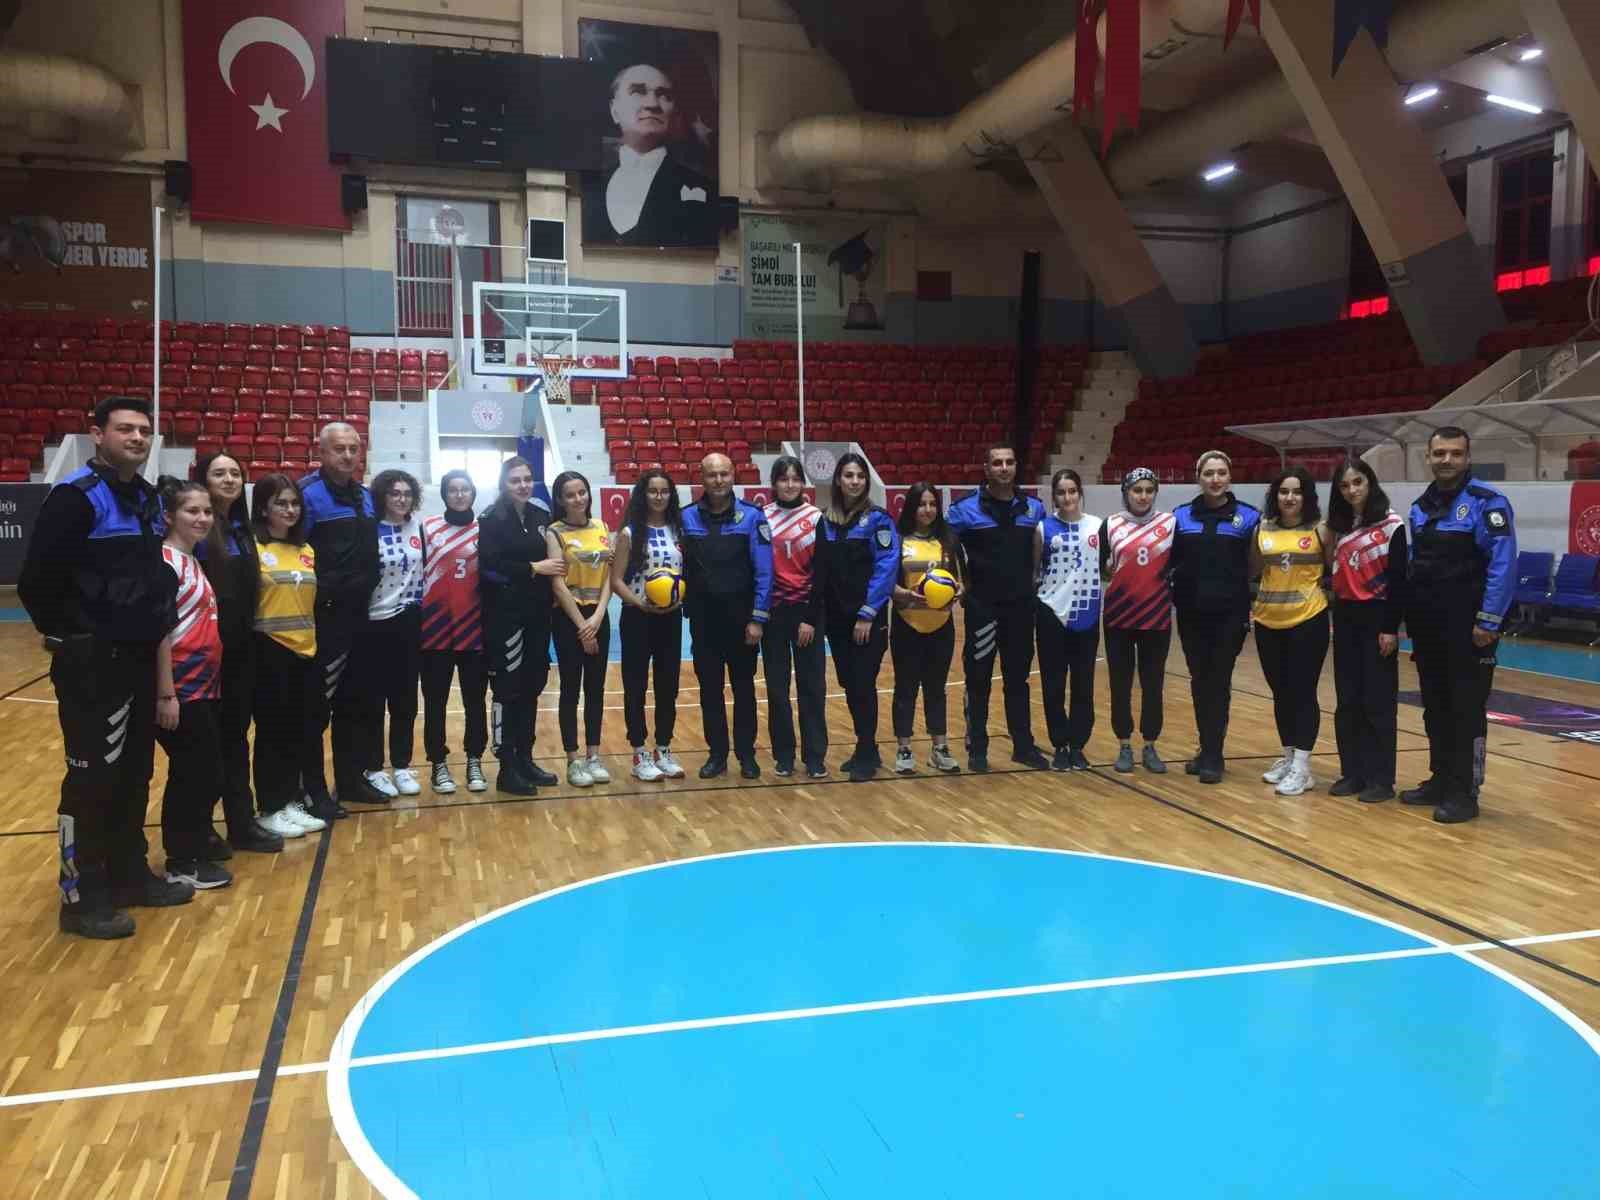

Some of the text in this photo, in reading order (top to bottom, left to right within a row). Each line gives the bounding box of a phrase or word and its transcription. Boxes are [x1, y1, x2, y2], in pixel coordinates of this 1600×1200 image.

[63, 222, 106, 243] SPOR
[752, 273, 771, 286] TAM
[784, 541, 792, 559] 1
[1072, 551, 1083, 569] 3
[1136, 546, 1149, 567] 8
[1348, 550, 1360, 571] 4
[454, 558, 467, 579] 3
[1280, 552, 1291, 573] 3
